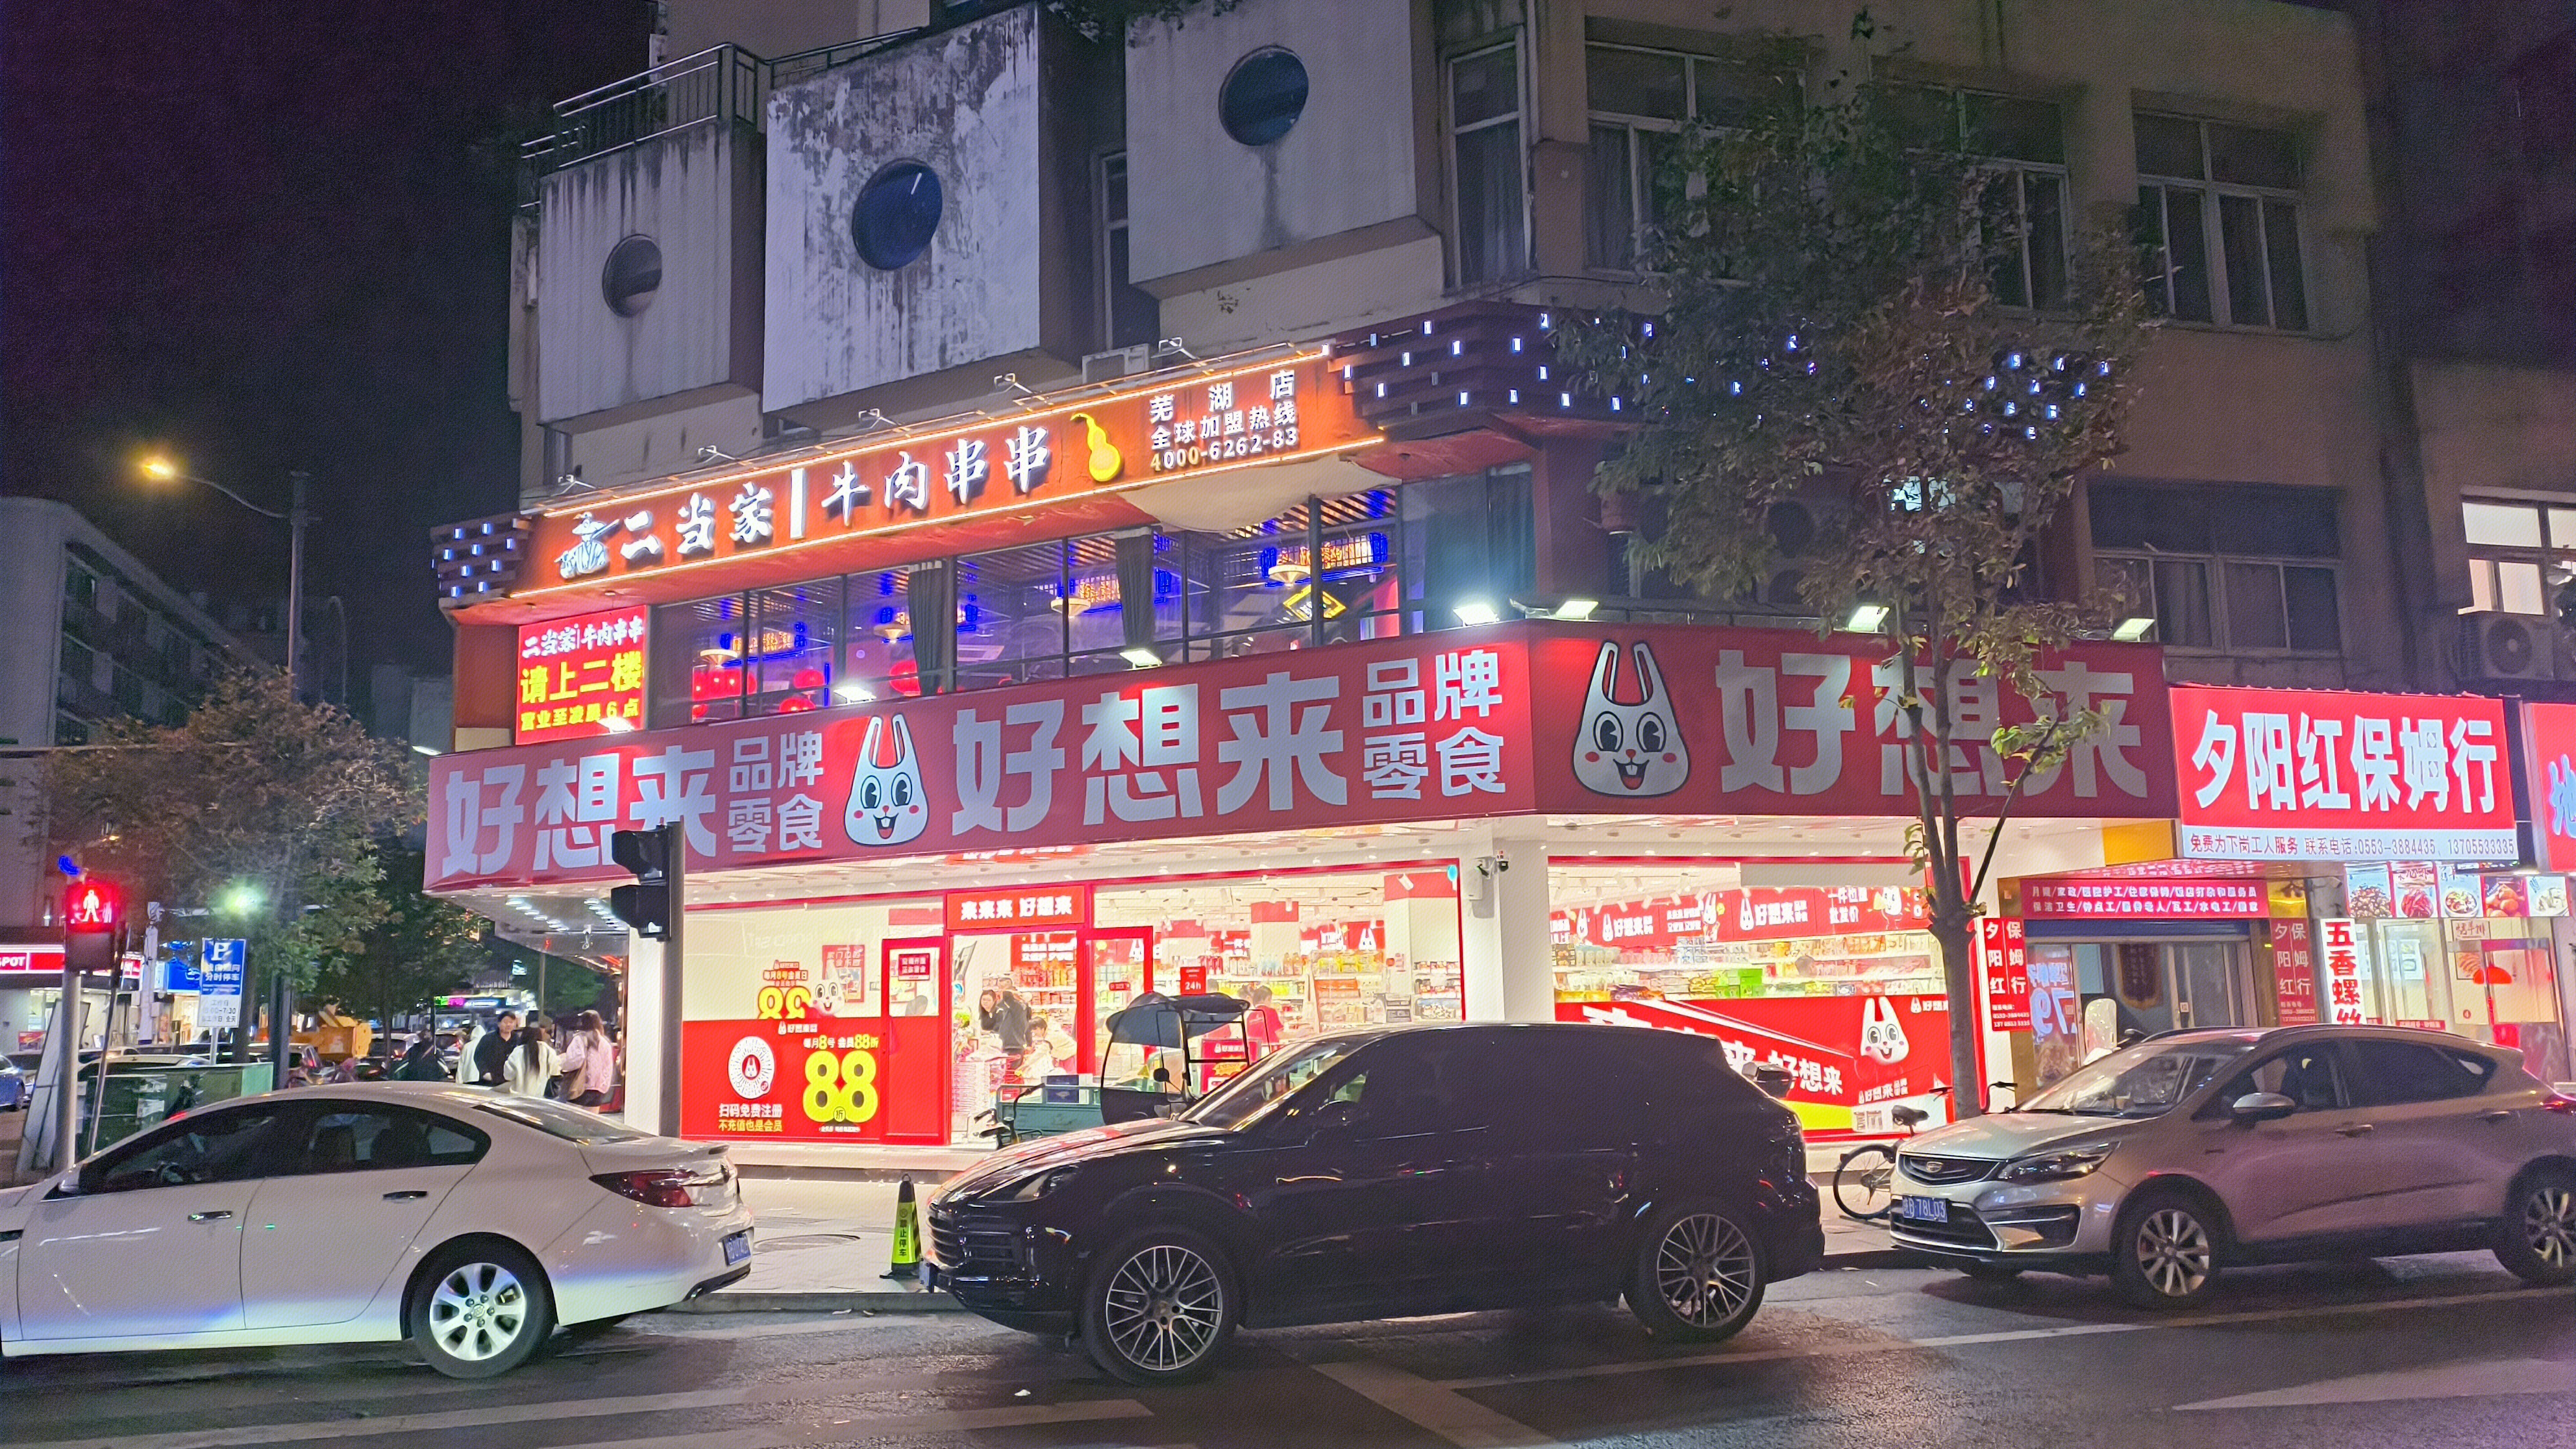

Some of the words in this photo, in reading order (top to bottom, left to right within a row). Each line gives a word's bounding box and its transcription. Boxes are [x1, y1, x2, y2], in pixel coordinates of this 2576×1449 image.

[1150, 369, 1296, 423] 芜湖店
[1150, 401, 1296, 451] 全球加盟热线
[1150, 427, 1298, 472] 4000-6262-83
[619, 481, 774, 560] 二当家
[821, 426, 1051, 526] 牛肉串串
[522, 626, 576, 658] 二当家
[581, 615, 643, 650] 牛肉串串
[520, 650, 642, 704] 请上二楼
[1363, 649, 1503, 728] 品牌
[521, 698, 639, 732] 营业至凌晨6点
[1716, 648, 2148, 799] 好想来
[729, 730, 824, 793] 品牌
[952, 671, 1348, 837] 好想来
[1362, 725, 1507, 800] 零食
[2191, 708, 2498, 813] 夕阳红保姆行
[442, 745, 717, 877] 好想来
[727, 793, 823, 854] 零食
[2190, 833, 2299, 856] 免费为下岗工人服务
[1185, 982, 1202, 991] 24h
[1985, 922, 2006, 995] 夕阳红
[2006, 921, 2027, 995] 保姆行
[2274, 923, 2296, 996] 夕阳红
[2291, 922, 2312, 995] 保姆行
[837, 1034, 879, 1050] 会员88折
[718, 1103, 783, 1118] 扫码免费注册
[802, 1050, 879, 1123] 88
[718, 1119, 783, 1132] 不充值也是会员
